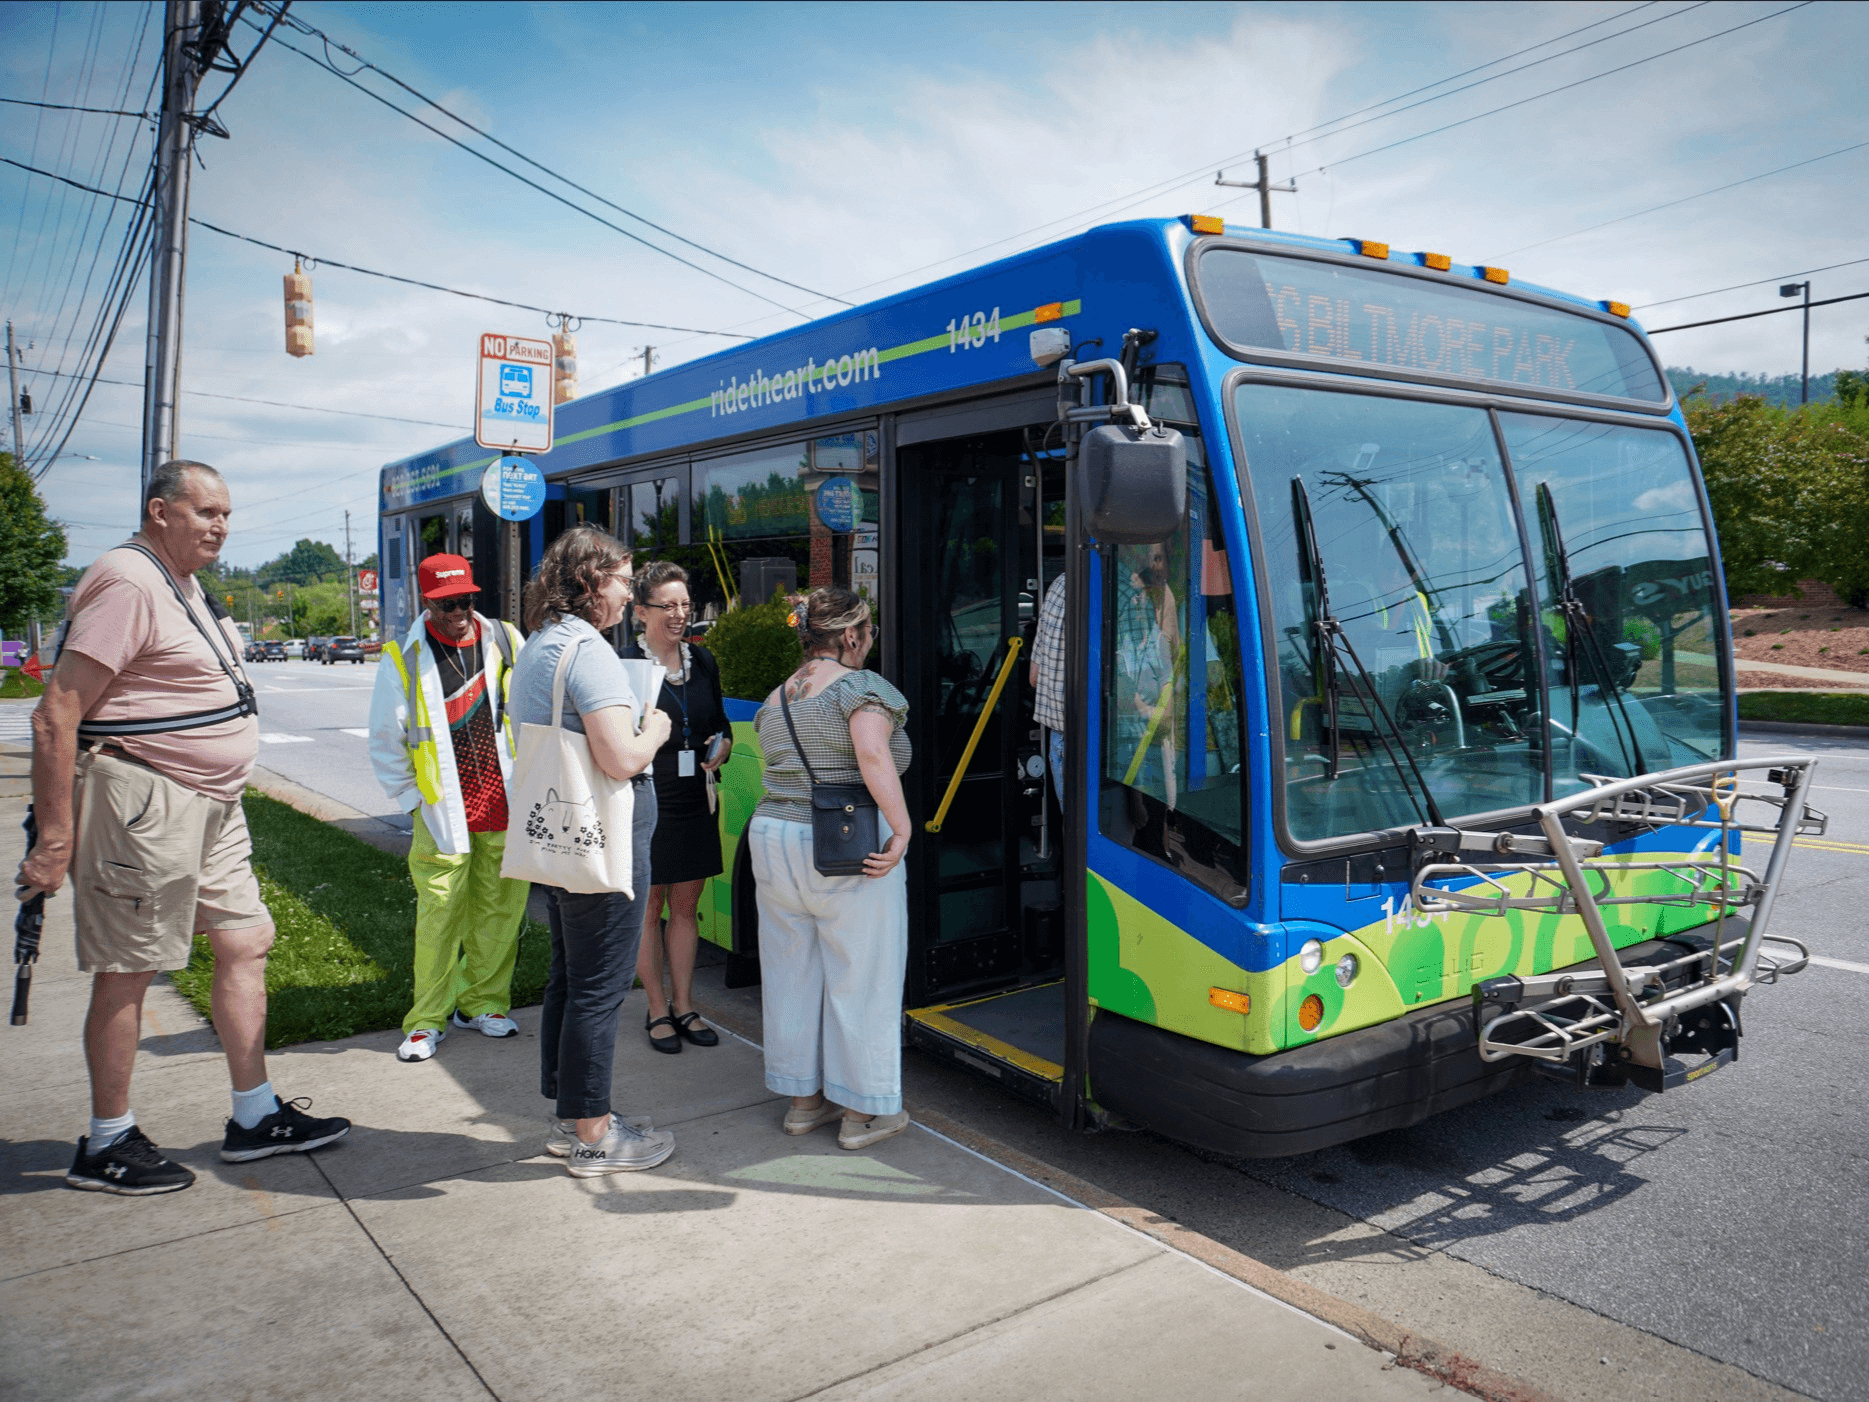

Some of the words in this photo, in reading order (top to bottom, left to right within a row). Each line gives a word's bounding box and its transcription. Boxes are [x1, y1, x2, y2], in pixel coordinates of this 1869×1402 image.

[945, 306, 1001, 354] 1434
[1308, 294, 1486, 382] BILTMORE
[1494, 327, 1577, 391] PARK
[484, 336, 505, 357] NO
[509, 343, 549, 361] PARKING
[710, 346, 881, 419] ridetheart.com
[494, 397, 514, 414] Bus
[516, 400, 540, 419] Stop
[574, 1148, 606, 1159] HOKA
